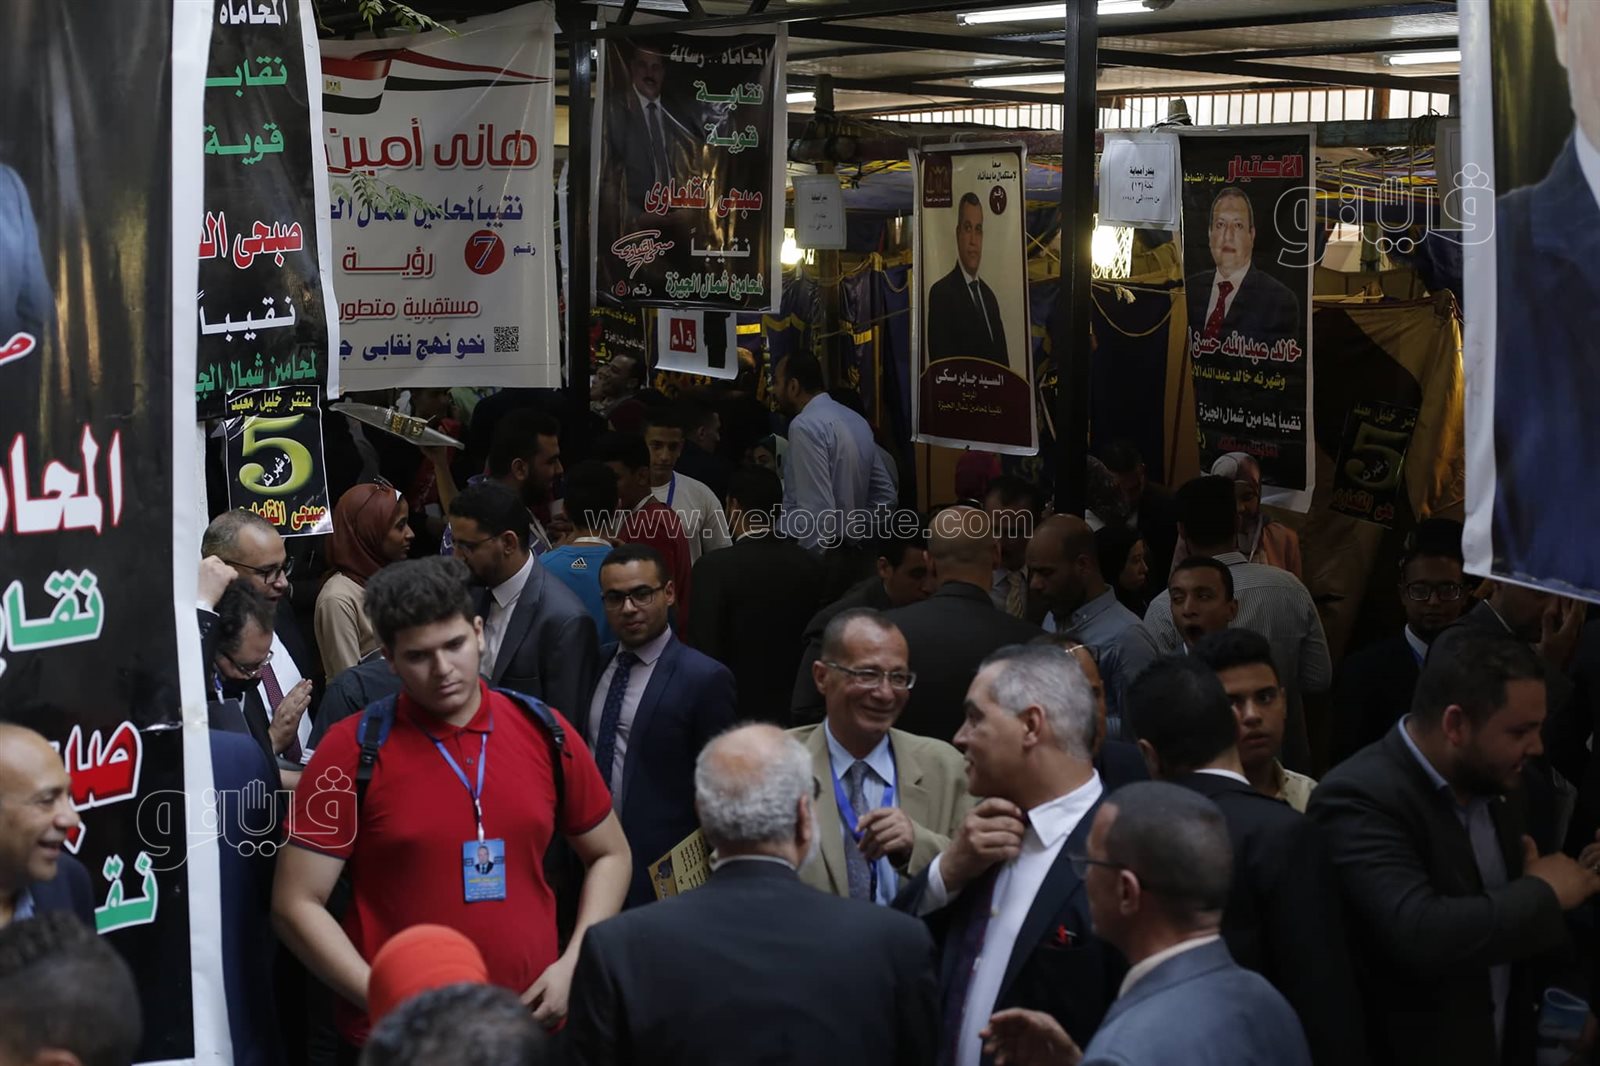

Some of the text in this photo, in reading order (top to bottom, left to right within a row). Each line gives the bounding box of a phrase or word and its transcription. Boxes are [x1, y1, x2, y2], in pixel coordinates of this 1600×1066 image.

[205, 56, 288, 97] نقاب
[693, 80, 764, 111] نقابة
[203, 122, 284, 165] قوية
[704, 123, 759, 154] قوية
[1225, 154, 1304, 183] الاختيار
[198, 210, 228, 259] ال
[342, 246, 433, 276] رؤية
[473, 234, 536, 270] 7 رقم
[631, 284, 652, 297] رقم
[665, 271, 701, 299] الجيزة
[700, 269, 729, 299] شمال
[339, 297, 479, 321] مستقبلية متطور
[416, 333, 452, 361] نهج
[457, 333, 486, 360] نحو
[1192, 331, 1221, 359] حسن
[1270, 338, 1303, 362] خالد
[195, 363, 222, 401] الجي
[226, 352, 264, 395] شمال
[958, 370, 978, 388] جابر
[978, 374, 1004, 389] السيد
[1232, 369, 1252, 383] خالد
[231, 390, 312, 415] عنتر خليل معبد
[1198, 402, 1223, 422] الجيزة
[1222, 407, 1244, 425] شمال
[239, 412, 313, 495] 5
[1344, 421, 1410, 489] 5
[0, 422, 123, 536] المحا
[0, 569, 104, 678] نقا
[63, 720, 143, 855] صب
[94, 851, 158, 934] نق
